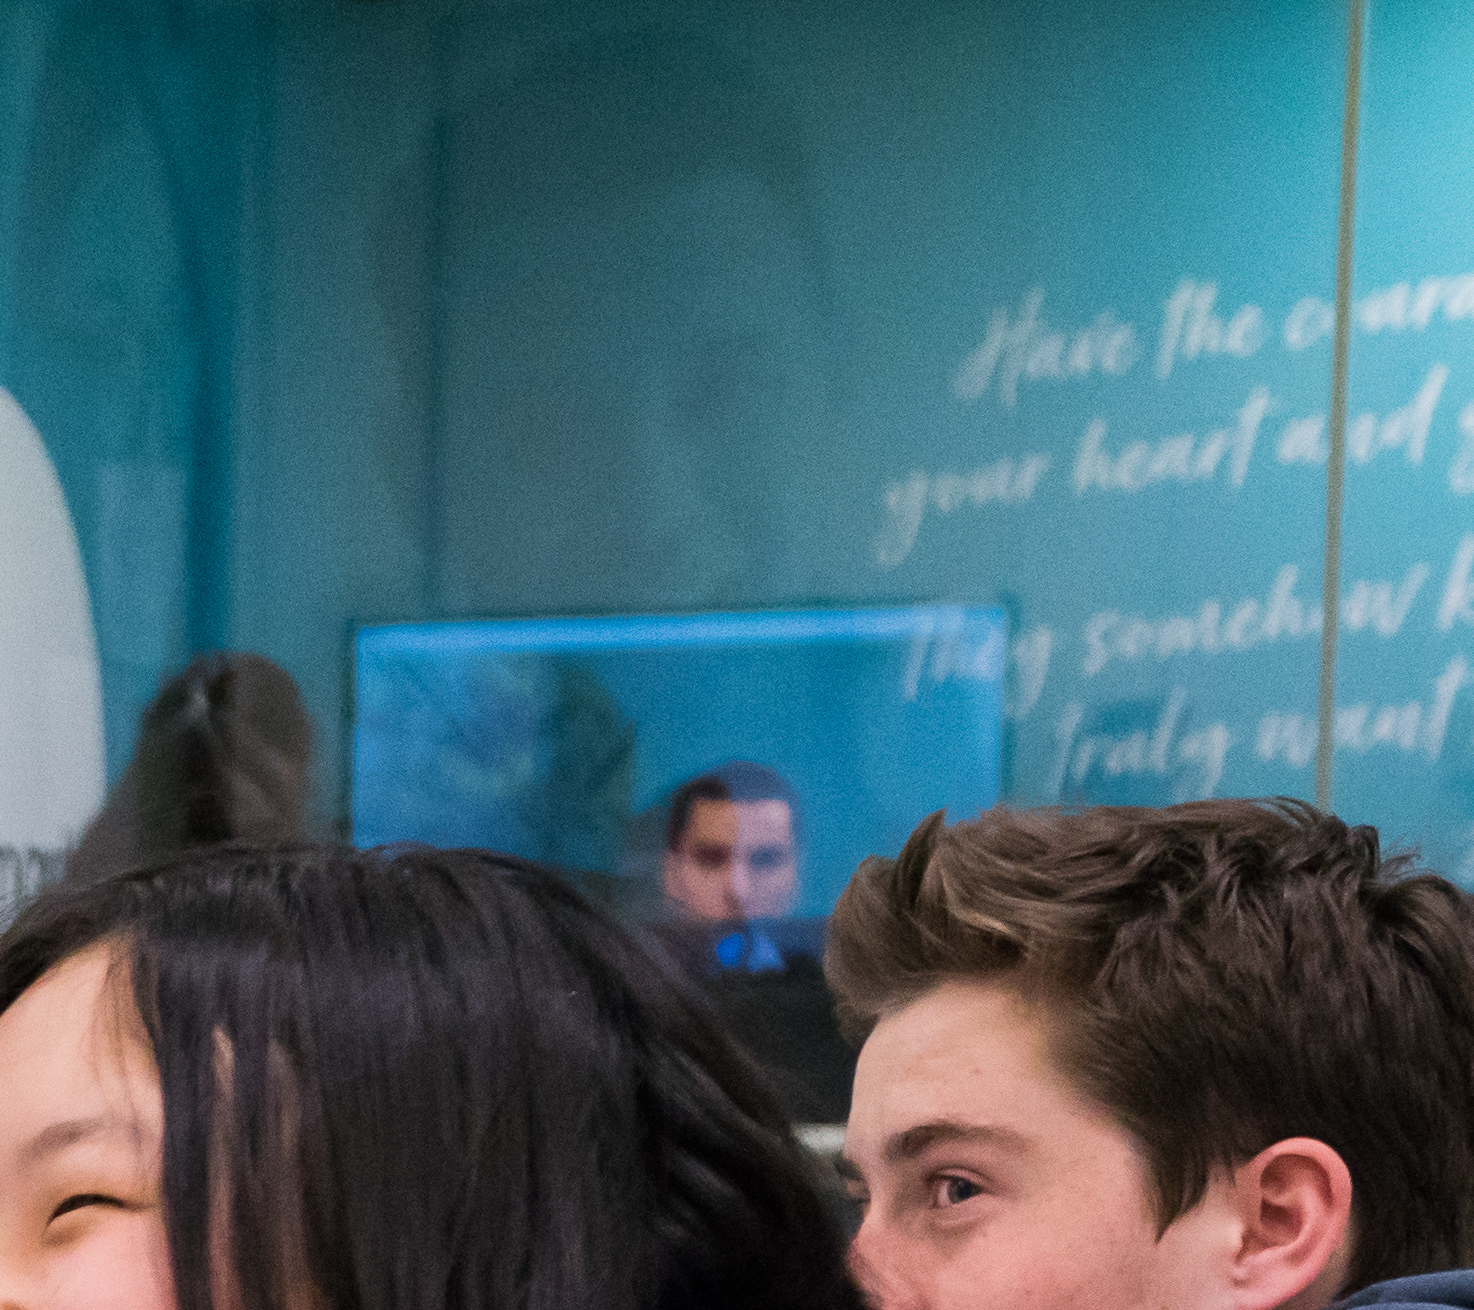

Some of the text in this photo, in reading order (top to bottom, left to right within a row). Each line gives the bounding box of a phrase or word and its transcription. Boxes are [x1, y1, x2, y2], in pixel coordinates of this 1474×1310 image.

[951, 287, 1138, 407] Have
[874, 454, 1051, 573] your
[1074, 386, 1270, 494] heart
[1278, 365, 1448, 466] and
